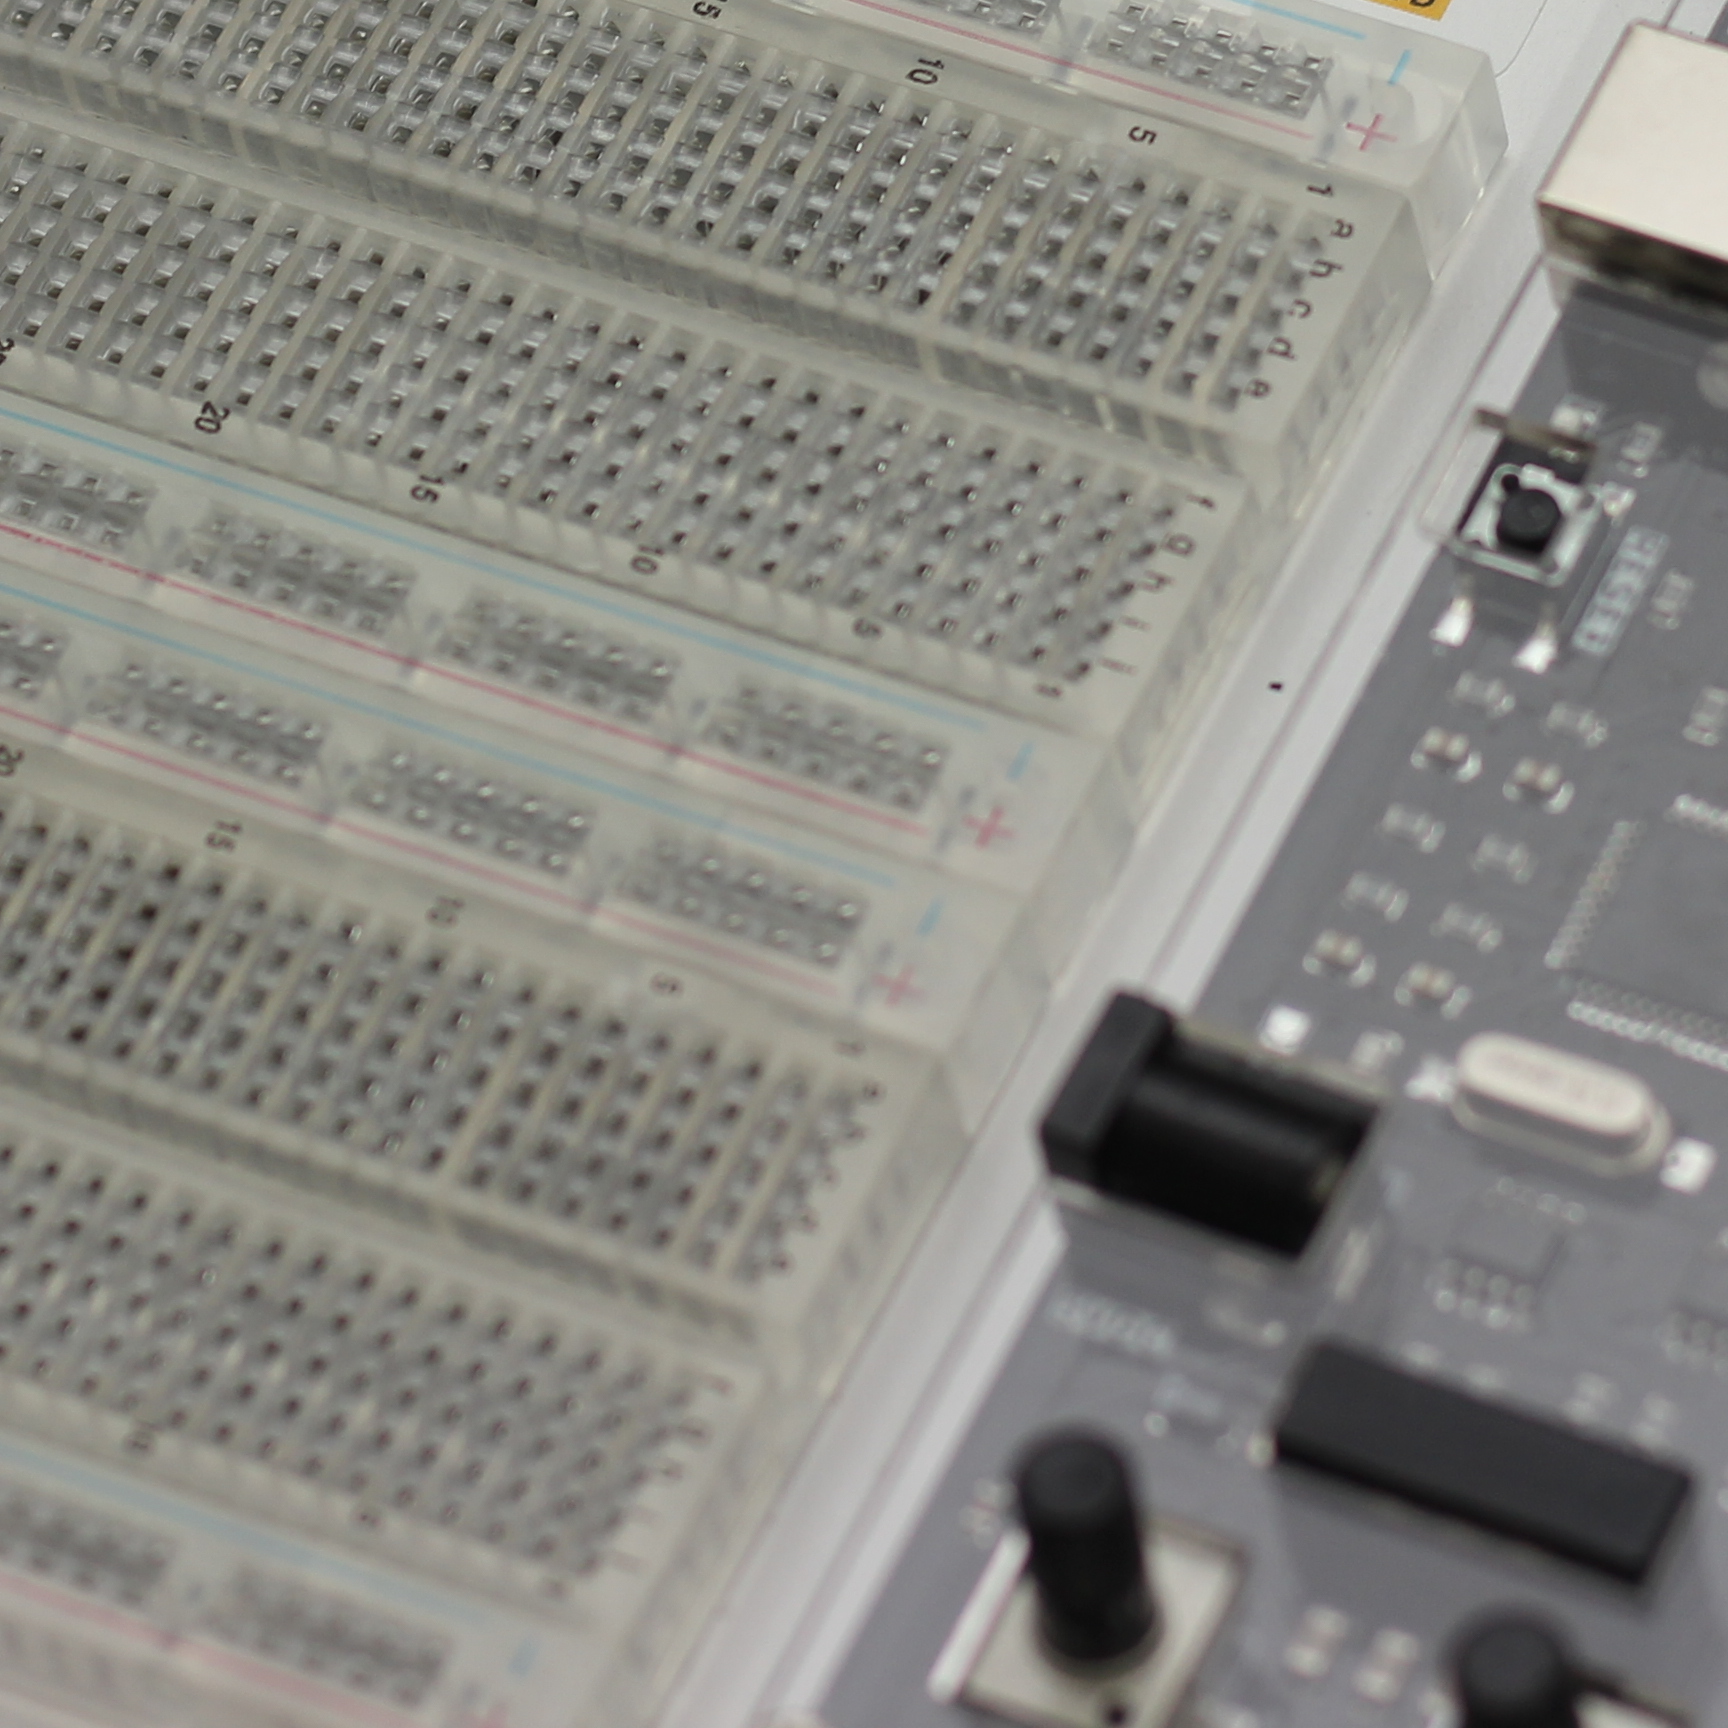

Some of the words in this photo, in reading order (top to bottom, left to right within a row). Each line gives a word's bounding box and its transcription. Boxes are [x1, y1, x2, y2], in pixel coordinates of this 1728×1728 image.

[906, 56, 946, 87] 10
[1128, 124, 1158, 147] 5
[1306, 183, 1335, 201] 1
[1330, 217, 1356, 241] a
[1308, 256, 1341, 280] b
[1287, 297, 1313, 321] c
[1266, 334, 1297, 361] d
[193, 400, 232, 435] 20
[410, 473, 446, 504] 15
